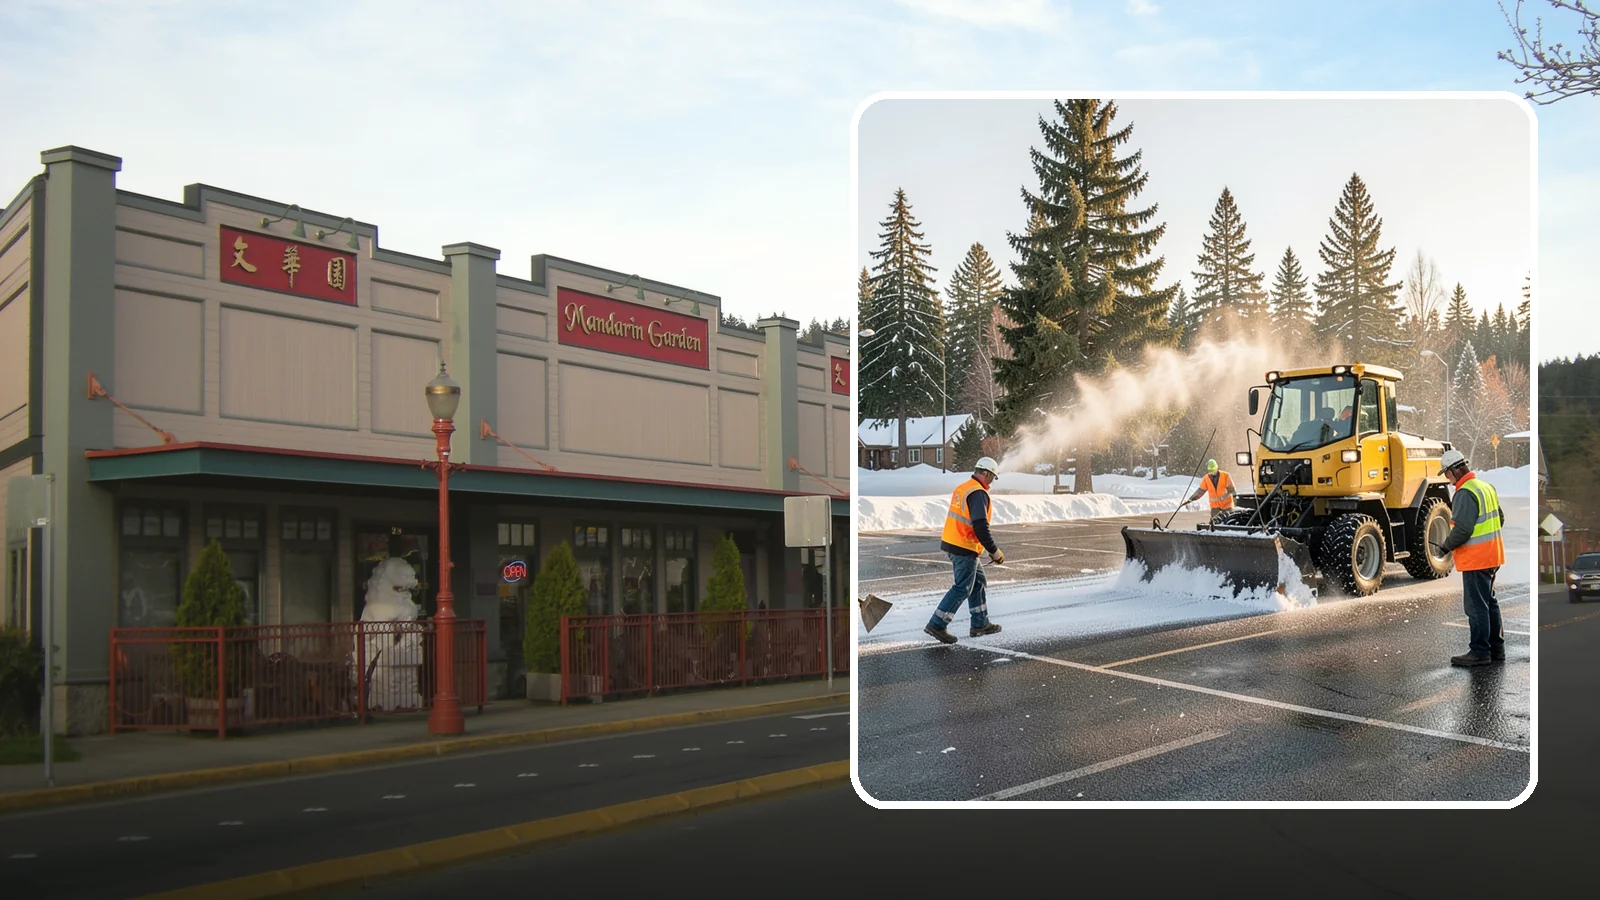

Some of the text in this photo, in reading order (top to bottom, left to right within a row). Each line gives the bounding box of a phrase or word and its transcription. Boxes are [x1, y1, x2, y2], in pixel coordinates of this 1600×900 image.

[231, 235, 346, 291] 文華園
[564, 302, 702, 352] Mandarin Garden
[503, 565, 527, 578] OPEN
